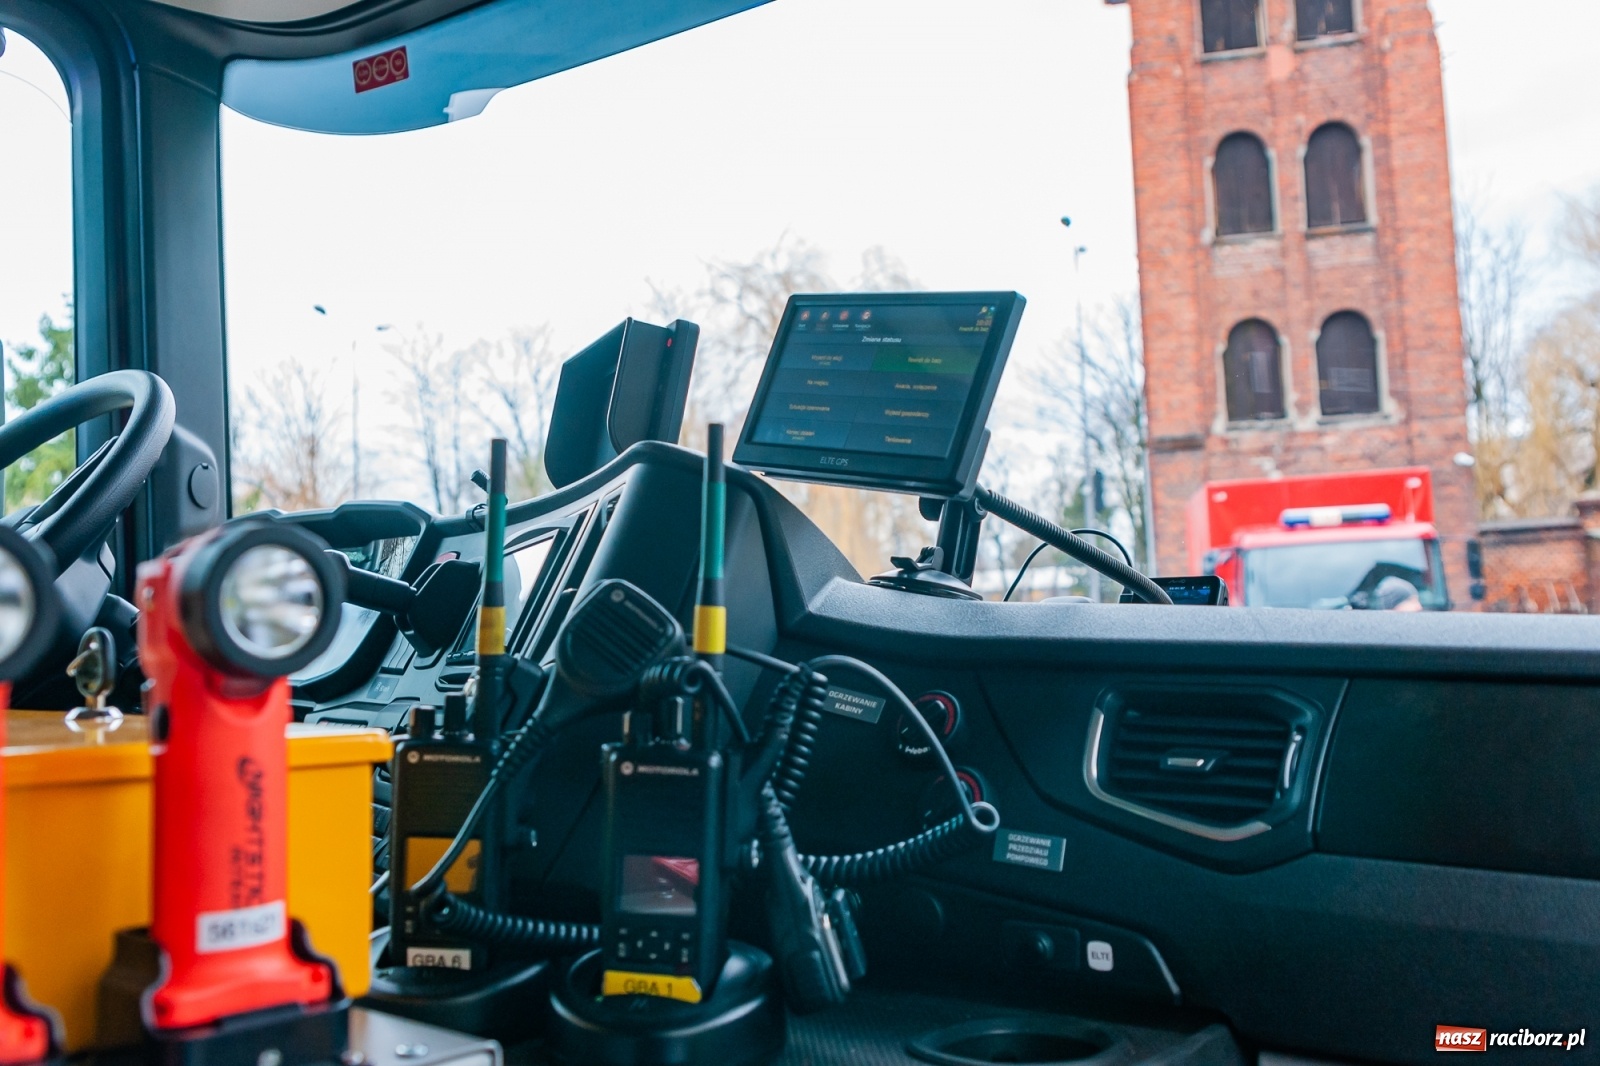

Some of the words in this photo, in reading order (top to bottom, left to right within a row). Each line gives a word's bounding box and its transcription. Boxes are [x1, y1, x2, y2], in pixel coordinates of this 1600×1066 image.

[819, 456, 836, 465] ELTE
[828, 690, 877, 709] OGRZEWANIE
[834, 702, 864, 716] KABINY
[422, 754, 481, 763] MOTOROLA
[637, 765, 699, 776] MOTOROLA
[1007, 833, 1052, 848] OGRZEWANIE
[1006, 852, 1049, 867] POMPOWEGO
[412, 953, 446, 968] GBA
[1091, 951, 1111, 962] ELTE
[623, 978, 660, 997] GBA
[666, 982, 673, 998] 1
